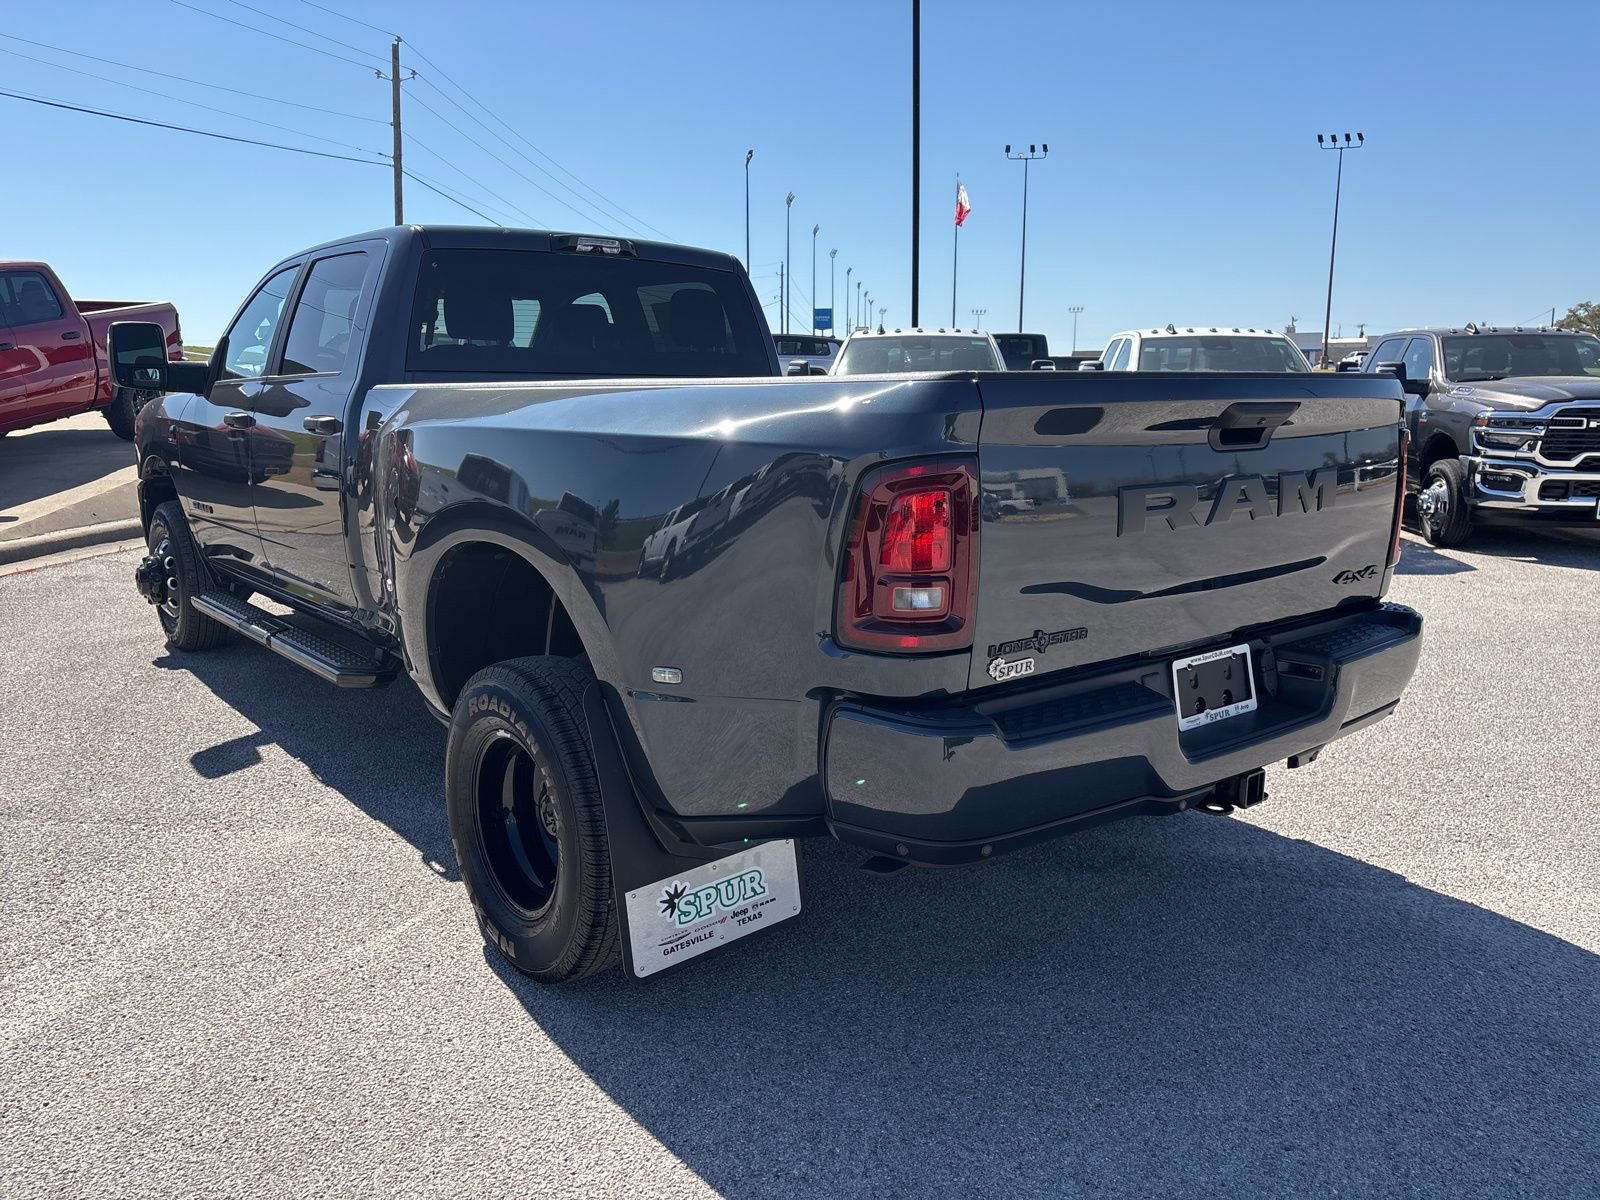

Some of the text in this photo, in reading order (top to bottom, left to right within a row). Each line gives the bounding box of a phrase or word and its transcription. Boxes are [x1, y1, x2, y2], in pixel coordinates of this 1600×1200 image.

[1117, 467, 1338, 537] RAM
[987, 628, 1088, 658] LONE STAR
[998, 660, 1032, 678] SPUR
[1209, 709, 1231, 721] SPUR
[677, 869, 766, 925] SPUR
[730, 907, 749, 920] Jeep
[663, 911, 763, 956] GATESVILLE TEXAS
